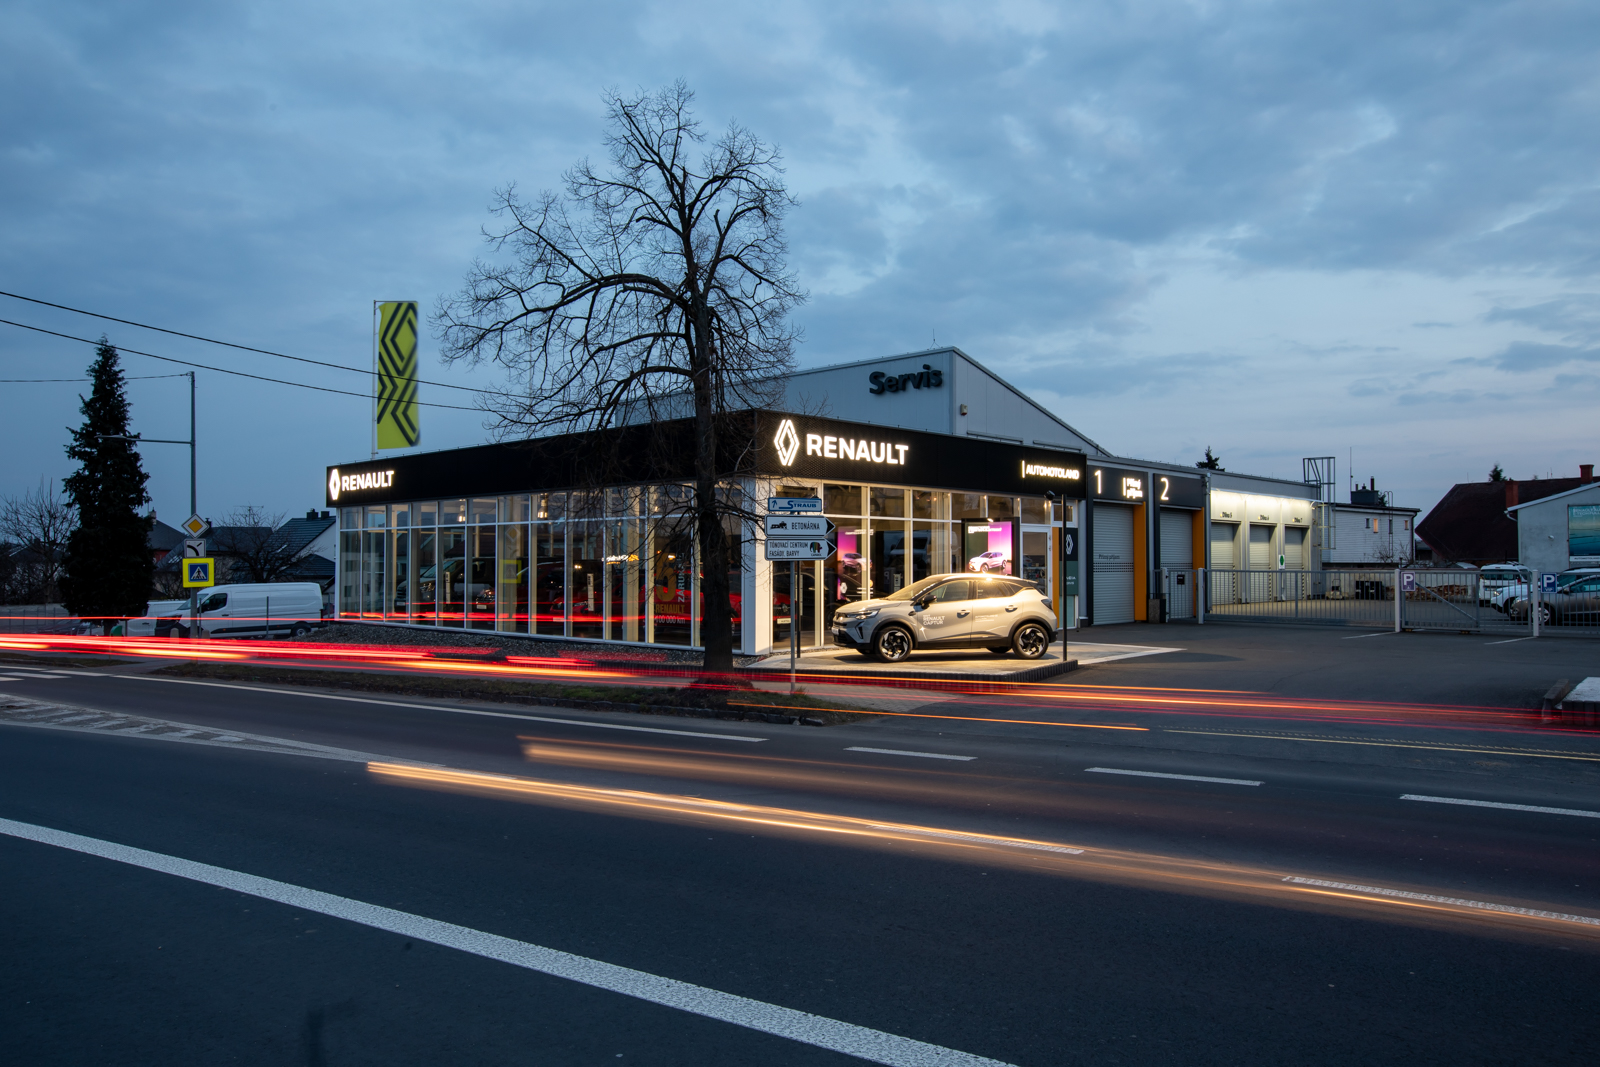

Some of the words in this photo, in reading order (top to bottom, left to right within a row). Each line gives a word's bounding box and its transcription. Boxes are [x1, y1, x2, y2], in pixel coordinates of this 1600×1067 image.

[869, 364, 943, 394] Servis
[806, 433, 909, 465] RENAULT
[1025, 464, 1080, 480] AUTOMOTOLAND
[341, 470, 395, 491] RENAULT
[1094, 470, 1102, 494] 1
[1160, 477, 1170, 500] 2
[787, 500, 817, 509] STRAUB
[791, 520, 820, 530] BETONÁRNA
[790, 541, 808, 549] CENTRUM
[1403, 573, 1414, 586] P
[1543, 574, 1555, 587] P
[655, 603, 686, 614] RENAULT
[666, 615, 677, 624] 000
[677, 615, 686, 624] km
